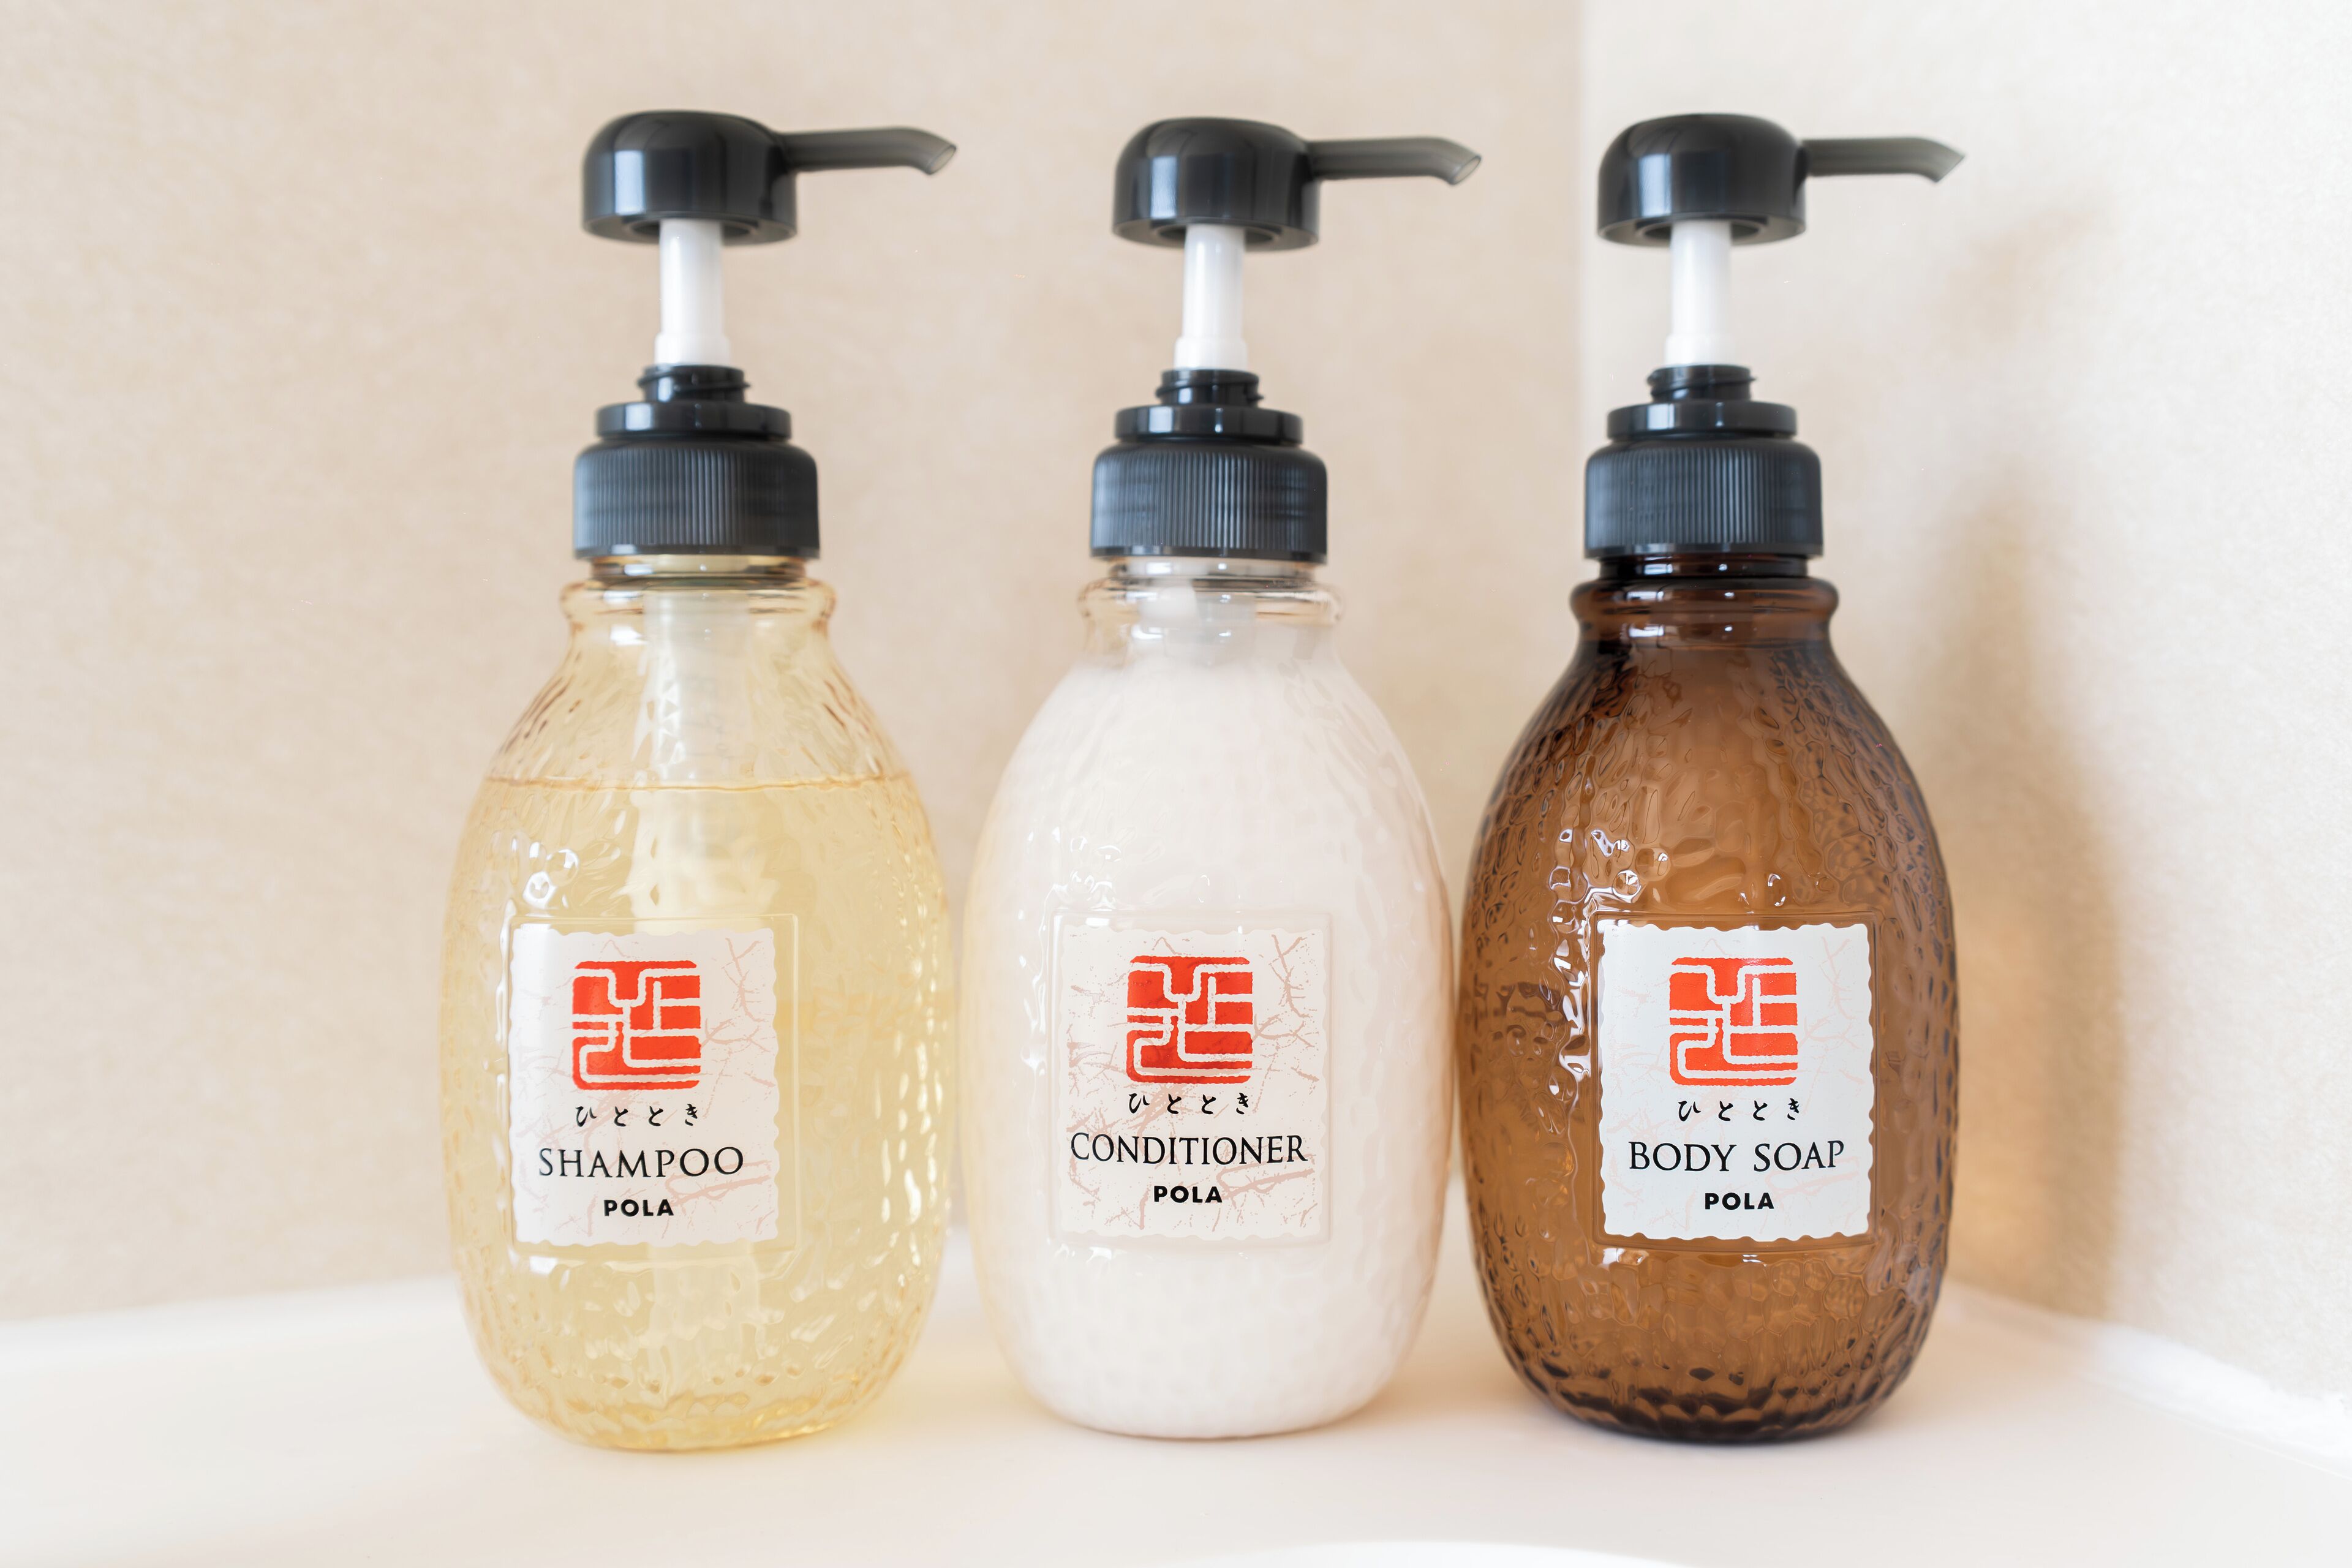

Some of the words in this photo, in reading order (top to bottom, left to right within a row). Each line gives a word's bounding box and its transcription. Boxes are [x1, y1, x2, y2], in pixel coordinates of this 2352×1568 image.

[575, 1102, 698, 1128] ひととき
[1128, 1091, 1250, 1115] ひととき
[1677, 1097, 1800, 1122] ひととき
[1070, 1132, 1309, 1166] CONDITIONER
[1628, 1140, 1737, 1172] BODY
[1753, 1140, 1845, 1172] SOAP
[538, 1146, 744, 1178] SHAMPOO
[1153, 1185, 1223, 1204] POLA
[1704, 1192, 1775, 1210] POLA
[603, 1198, 675, 1217] POLA
